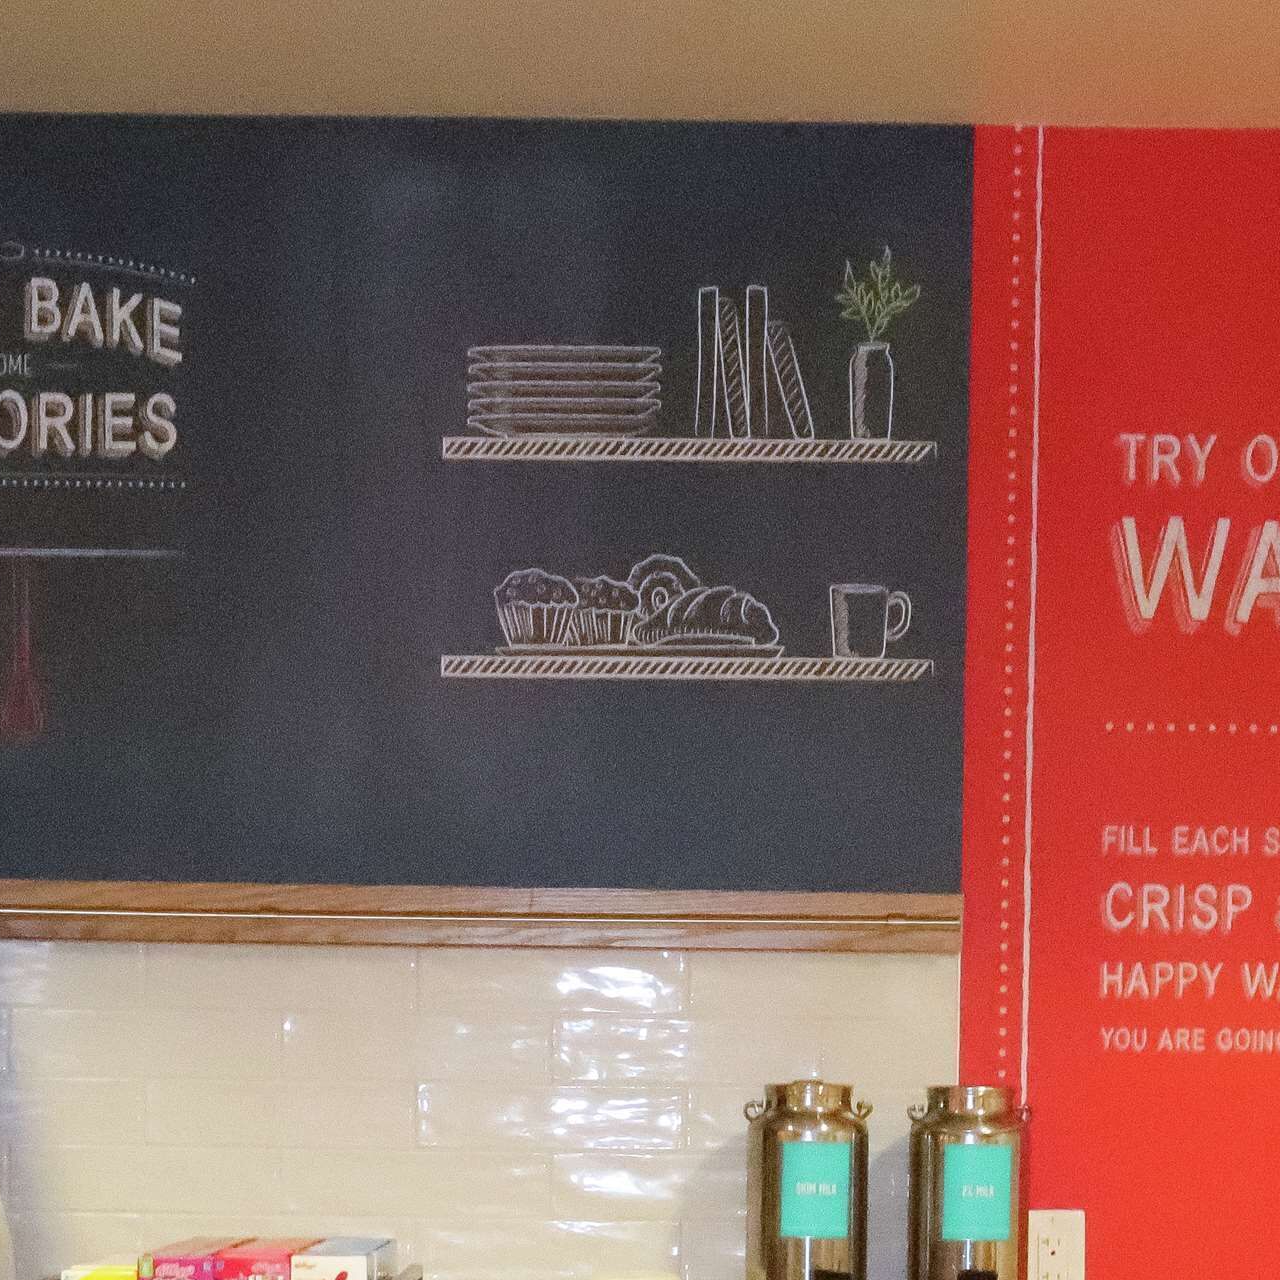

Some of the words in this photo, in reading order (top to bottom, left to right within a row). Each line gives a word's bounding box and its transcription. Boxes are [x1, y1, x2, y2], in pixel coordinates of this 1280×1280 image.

[24, 275, 183, 366] BAKE
[1119, 432, 1217, 489] TRY
[1103, 825, 1158, 855] FILL
[1173, 825, 1250, 856] EACH
[1101, 881, 1253, 934] CRISP
[1100, 961, 1223, 1000] HAPPY
[1100, 1026, 1147, 1052] YOU
[1157, 1027, 1206, 1052] ARE
